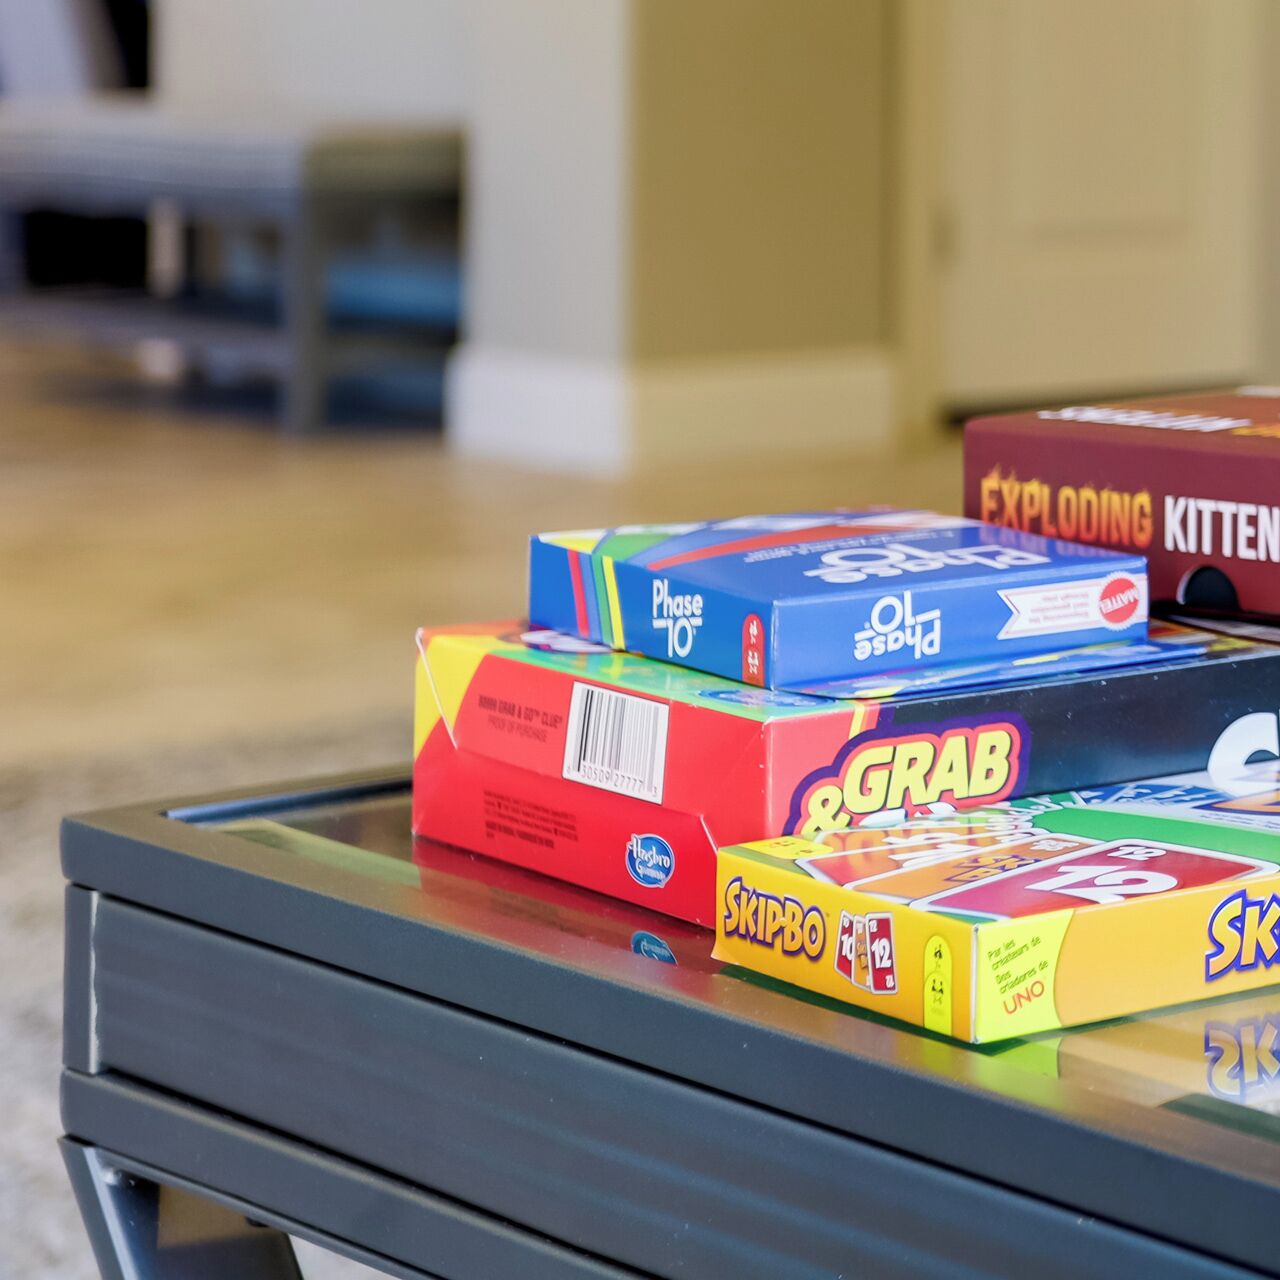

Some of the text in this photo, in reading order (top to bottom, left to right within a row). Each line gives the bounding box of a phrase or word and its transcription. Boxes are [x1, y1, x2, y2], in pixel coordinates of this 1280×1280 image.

[980, 472, 1153, 548] EXPLODING
[652, 579, 703, 619] Phase
[870, 590, 914, 634] 10
[664, 617, 694, 658] 10
[854, 617, 941, 661] Phase
[843, 731, 1011, 813] GRAB
[804, 784, 853, 836] &
[628, 838, 671, 868] Hasbro
[871, 937, 892, 969] 12
[1003, 980, 1045, 1014] UNO
